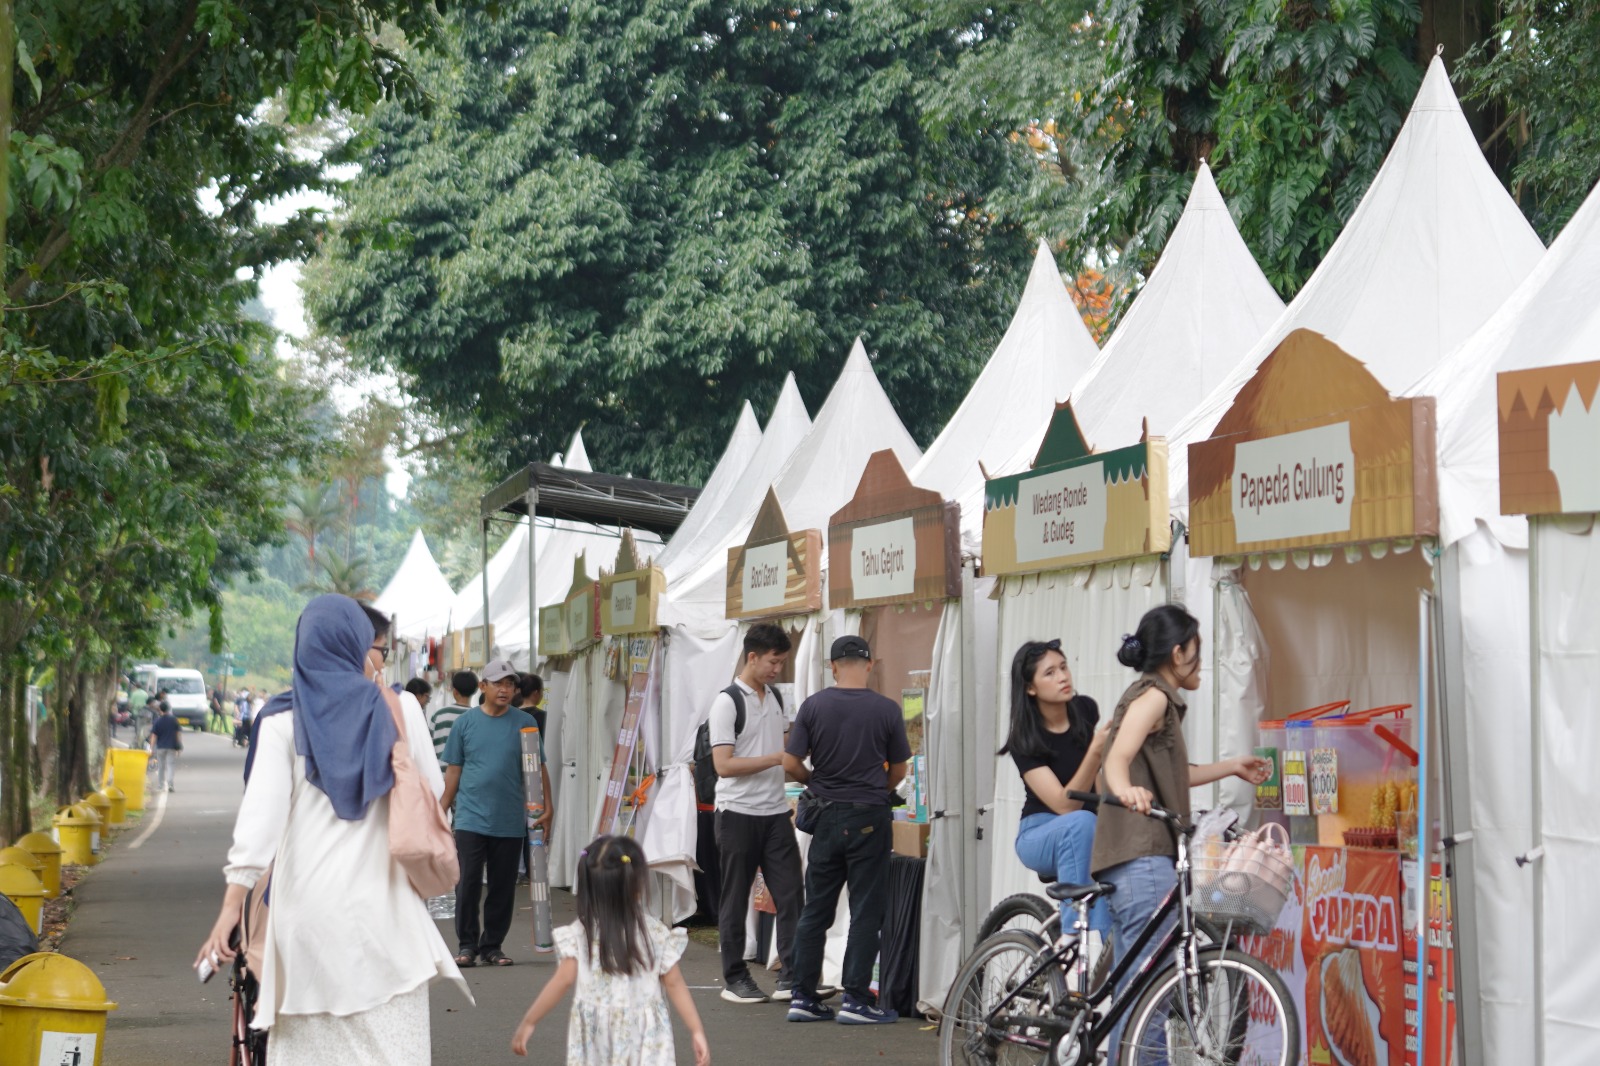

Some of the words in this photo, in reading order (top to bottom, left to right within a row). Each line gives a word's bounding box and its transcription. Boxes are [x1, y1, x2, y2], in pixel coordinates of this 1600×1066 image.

[1032, 489, 1062, 516] Wedang
[1063, 481, 1088, 509] Ronde
[1240, 463, 1290, 515] Papeda
[1293, 457, 1344, 504] Gulung
[1042, 521, 1049, 544] &
[1050, 516, 1075, 545] Gudeg
[862, 547, 879, 576] Tahu
[880, 542, 905, 581] Gejrot
[1310, 891, 1398, 952] PAPEDA
